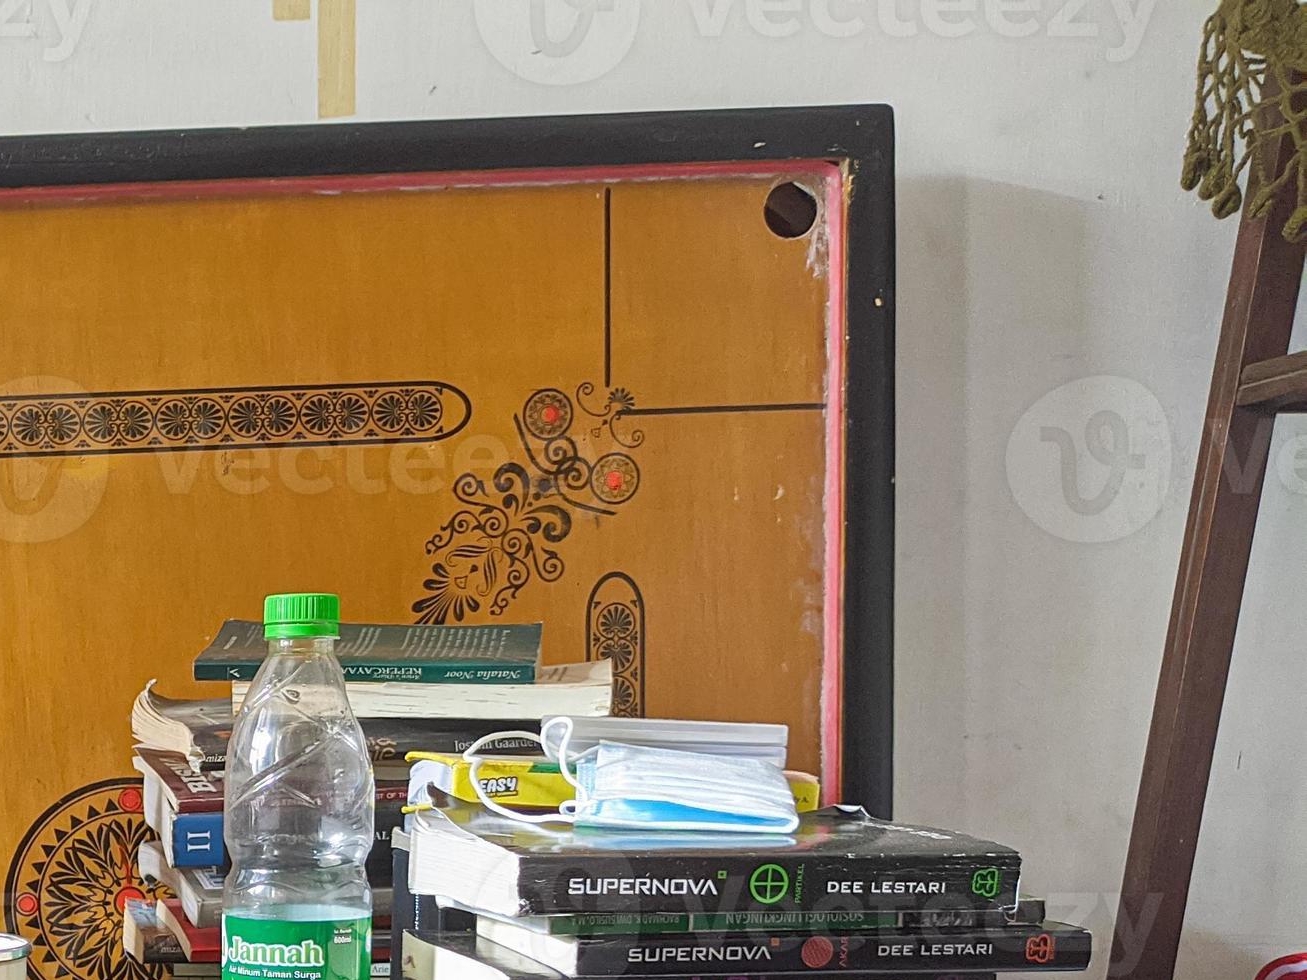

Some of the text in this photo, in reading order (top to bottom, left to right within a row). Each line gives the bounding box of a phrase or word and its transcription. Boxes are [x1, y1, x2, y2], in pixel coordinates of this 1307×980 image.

[444, 670, 521, 681] Natalia Noor
[478, 776, 518, 793] EASY
[568, 878, 946, 896] SUPERNOVA DEE LESTARI
[228, 936, 325, 967] Jannah
[627, 943, 993, 963] SUPERNOVA DEE LESTARI
[237, 967, 261, 978] Minum
[262, 969, 292, 979] Taman
[294, 970, 322, 980] Surga
